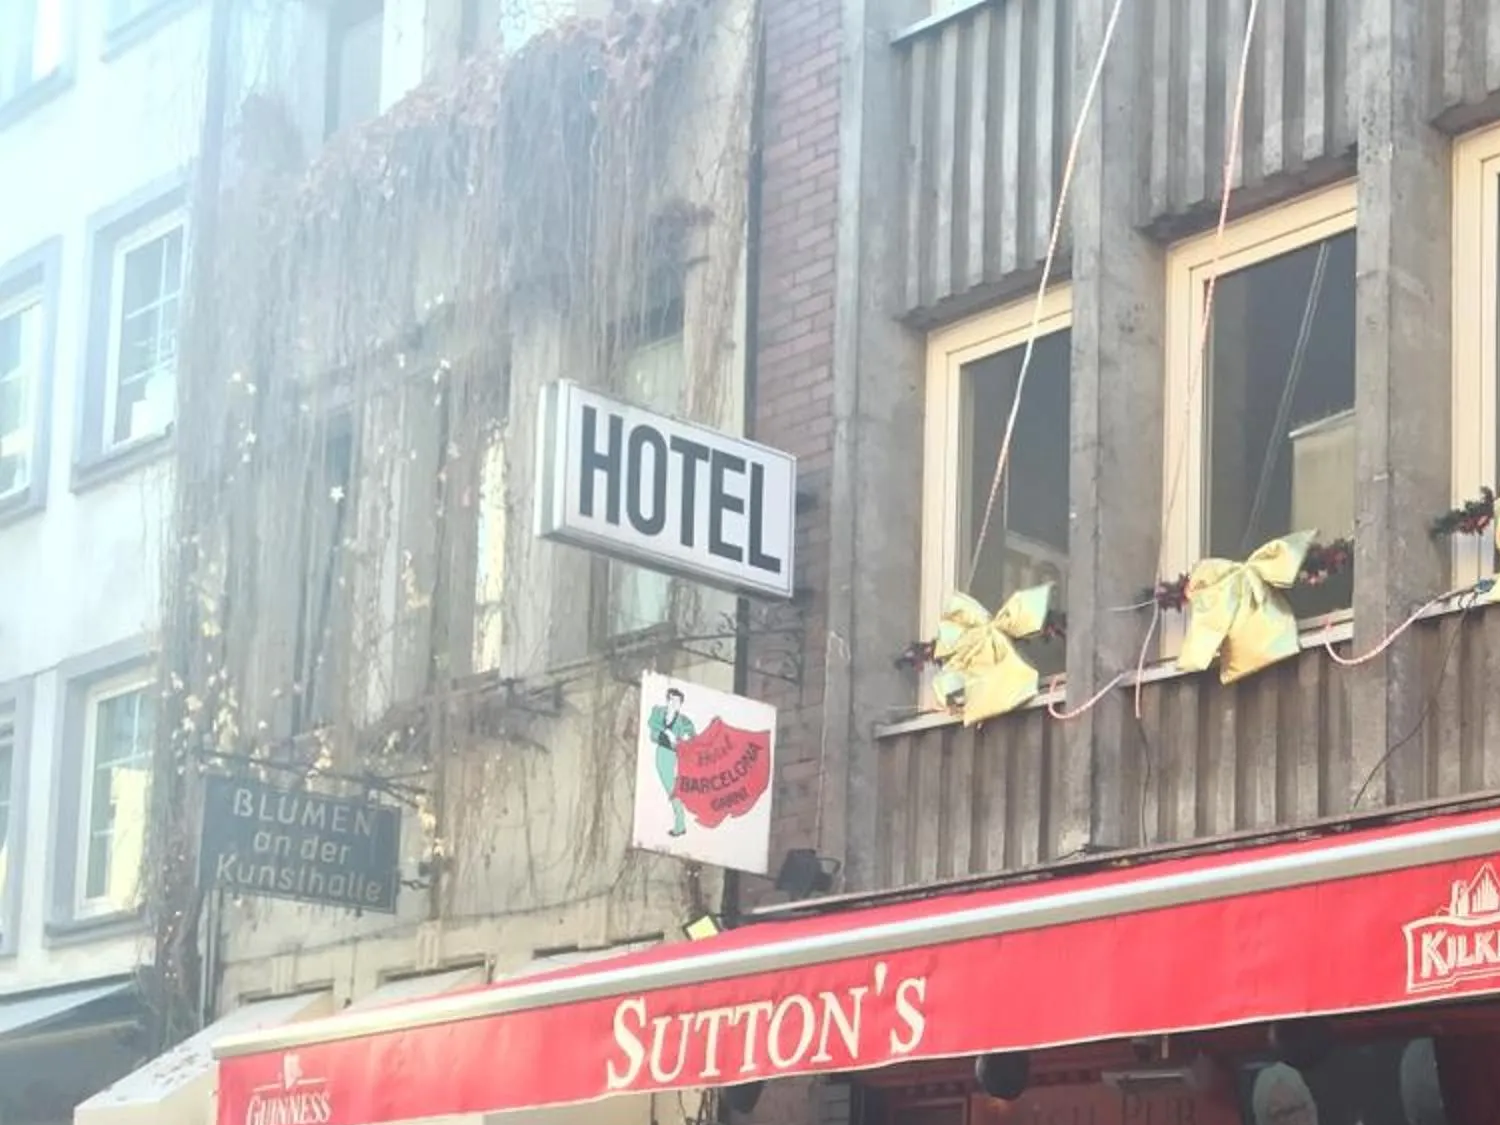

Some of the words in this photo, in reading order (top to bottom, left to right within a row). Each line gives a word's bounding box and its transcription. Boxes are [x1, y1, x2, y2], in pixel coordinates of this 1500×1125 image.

[579, 404, 782, 575] HOTEL
[677, 742, 765, 796] BARCELONA
[232, 787, 373, 837] BLUMEN
[253, 830, 291, 857] an
[300, 835, 352, 865] der
[215, 853, 383, 902] Kunsthalle
[606, 961, 928, 1090] SUTTON'S
